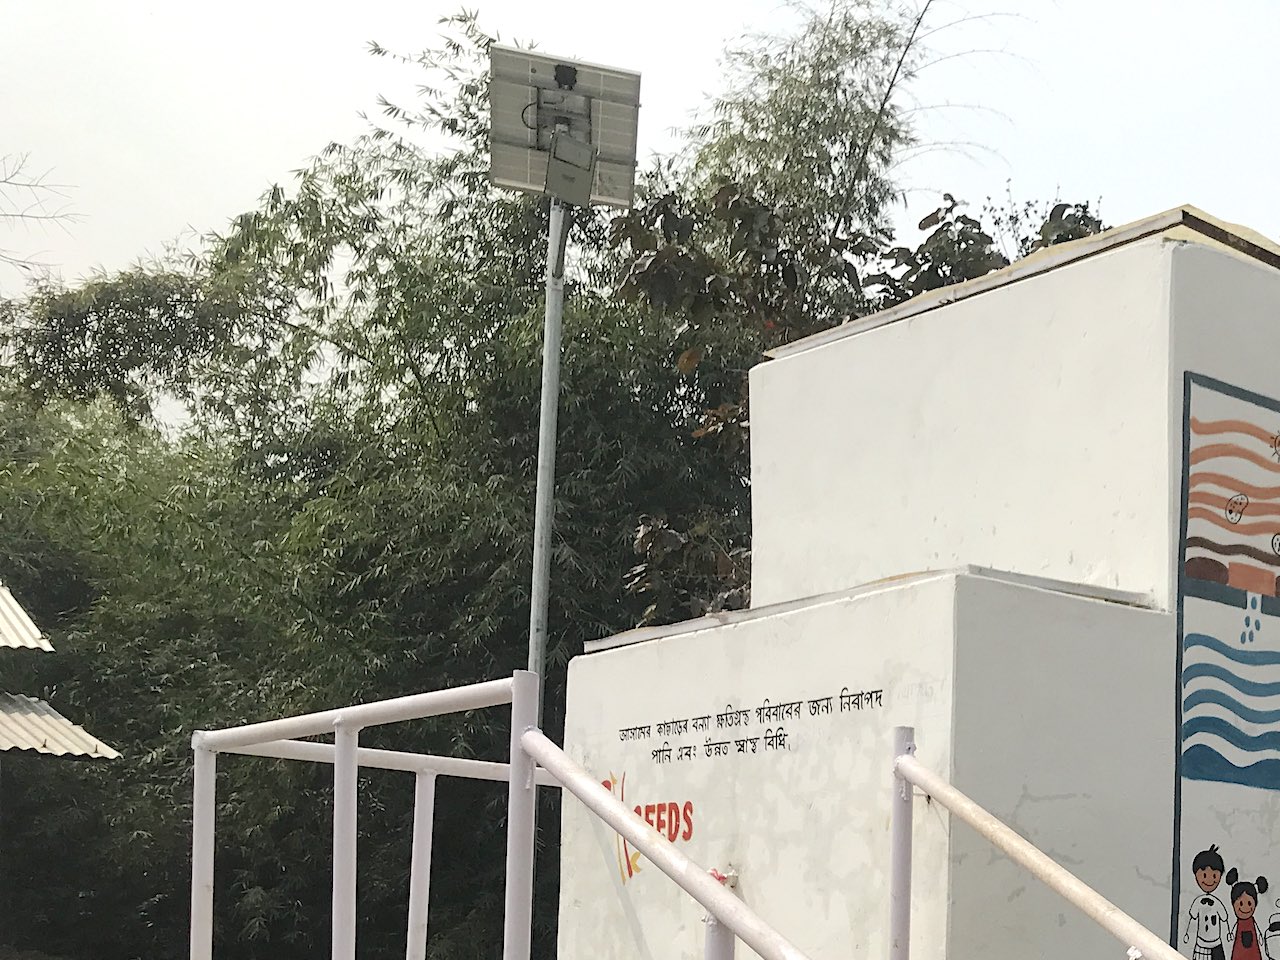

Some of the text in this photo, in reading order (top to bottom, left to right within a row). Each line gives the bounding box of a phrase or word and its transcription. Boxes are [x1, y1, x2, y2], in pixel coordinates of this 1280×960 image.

[619, 725, 651, 742] আসামের
[755, 698, 803, 724] পরিবারের
[808, 696, 833, 716] জন্য
[840, 687, 883, 712] নিরাপদ
[651, 741, 672, 764] পানি
[677, 745, 697, 761] এবং
[704, 736, 731, 757] উন্নত
[633, 800, 693, 843] EEDS
